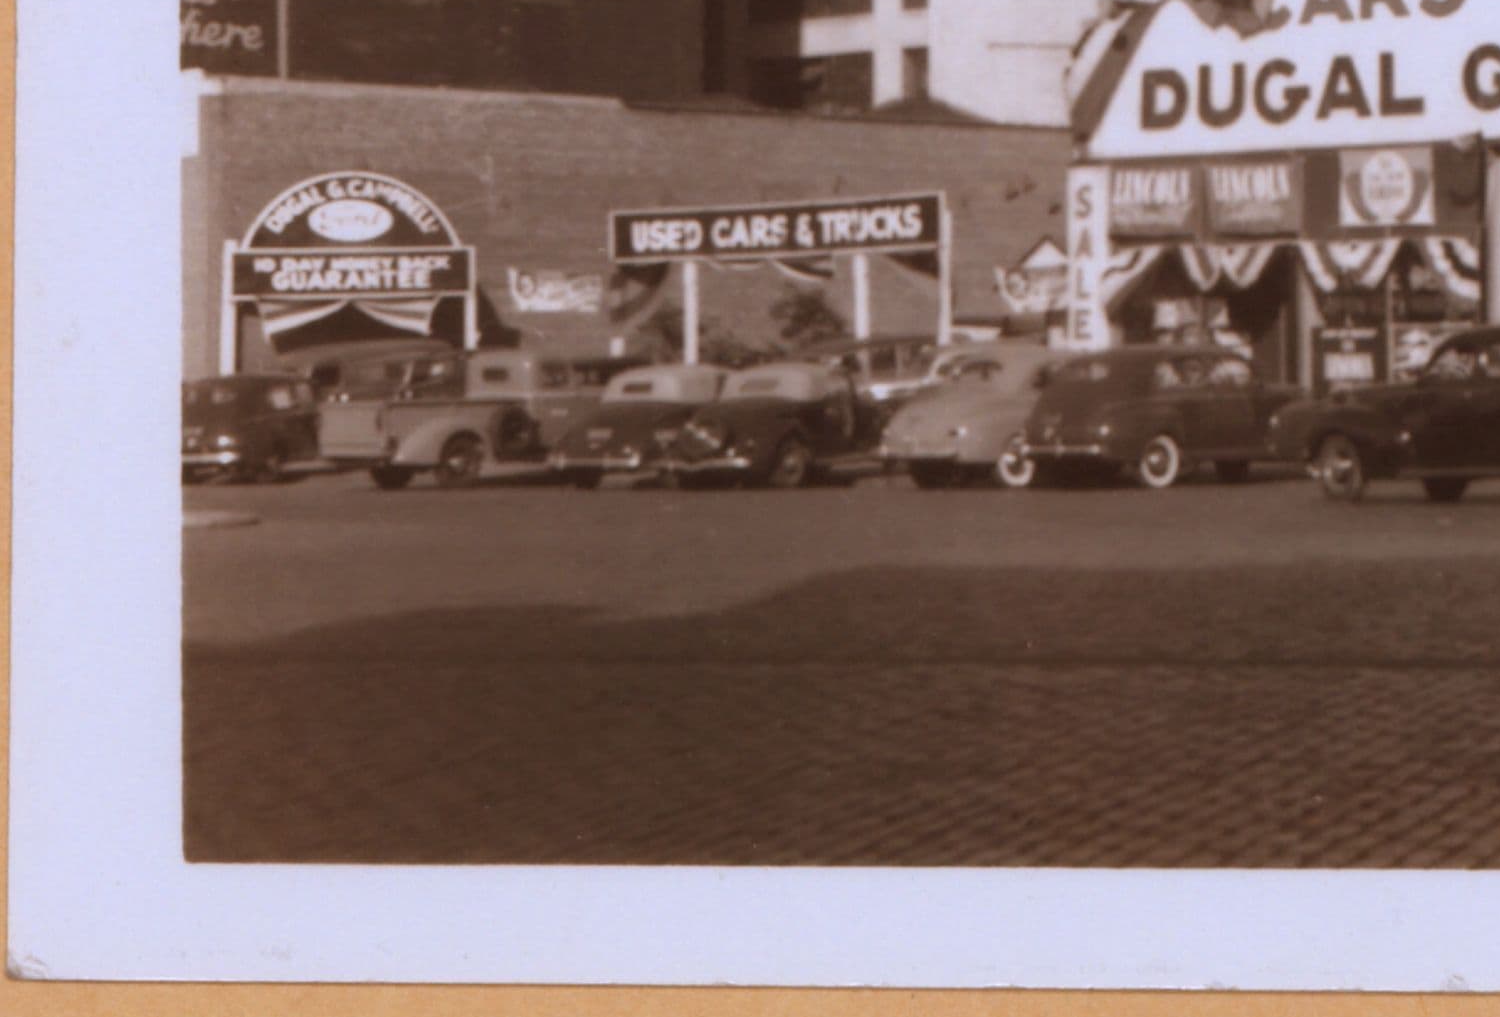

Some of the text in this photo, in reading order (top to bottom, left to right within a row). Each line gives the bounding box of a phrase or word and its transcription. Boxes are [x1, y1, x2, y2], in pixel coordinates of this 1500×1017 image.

[1140, 51, 1425, 131] DUGAL
[264, 185, 327, 235] DUGAL
[630, 203, 924, 253] USED CARS & TRUCKS
[270, 269, 432, 292] GUARANTEE
[280, 257, 326, 272] DAY
[329, 256, 394, 272] MONEY
[396, 255, 451, 270] BACK
[1073, 184, 1096, 341] SALE
